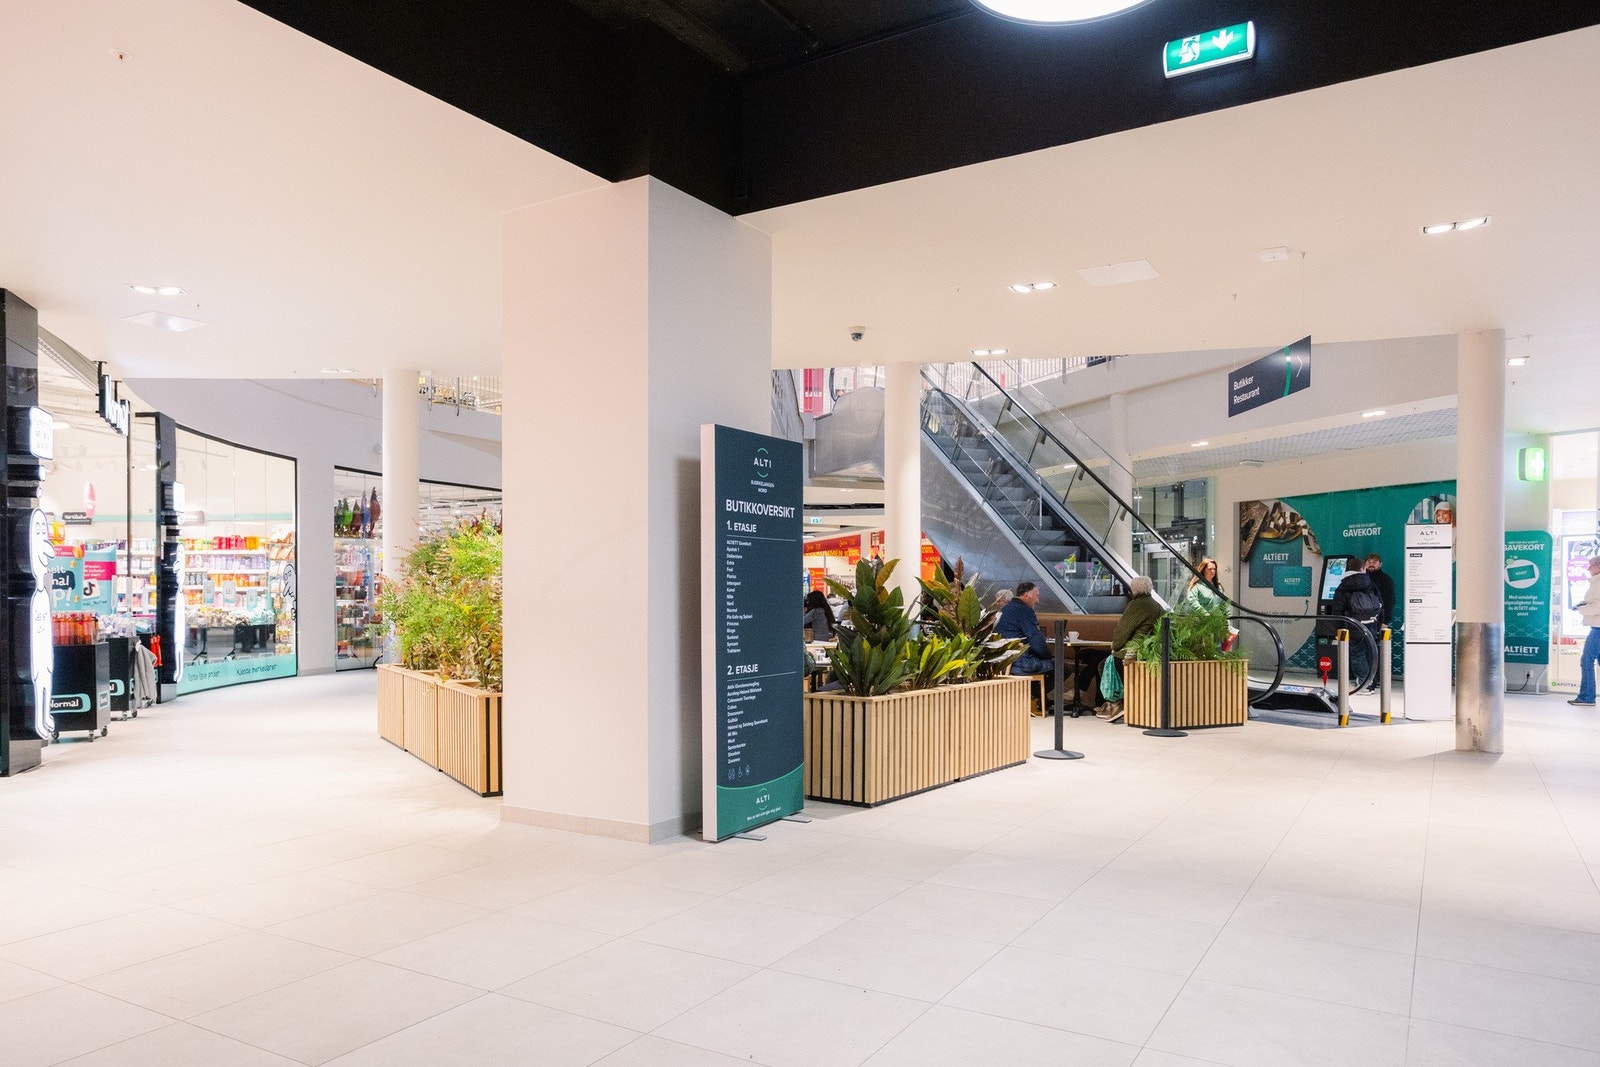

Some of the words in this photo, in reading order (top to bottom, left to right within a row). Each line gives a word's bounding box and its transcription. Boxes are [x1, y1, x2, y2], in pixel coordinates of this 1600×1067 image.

[1234, 376, 1254, 391] Butikker
[1234, 387, 1260, 404] Restaurant
[754, 457, 772, 468] ALTI
[726, 499, 795, 518] BUTIKKOVERSIKT
[727, 520, 732, 530] 1.
[734, 523, 757, 533] ETASJE
[1343, 527, 1382, 537] GAVEKORT
[727, 665, 734, 675] 2.
[736, 664, 758, 674] ETASJE
[756, 794, 770, 804] ALTI
